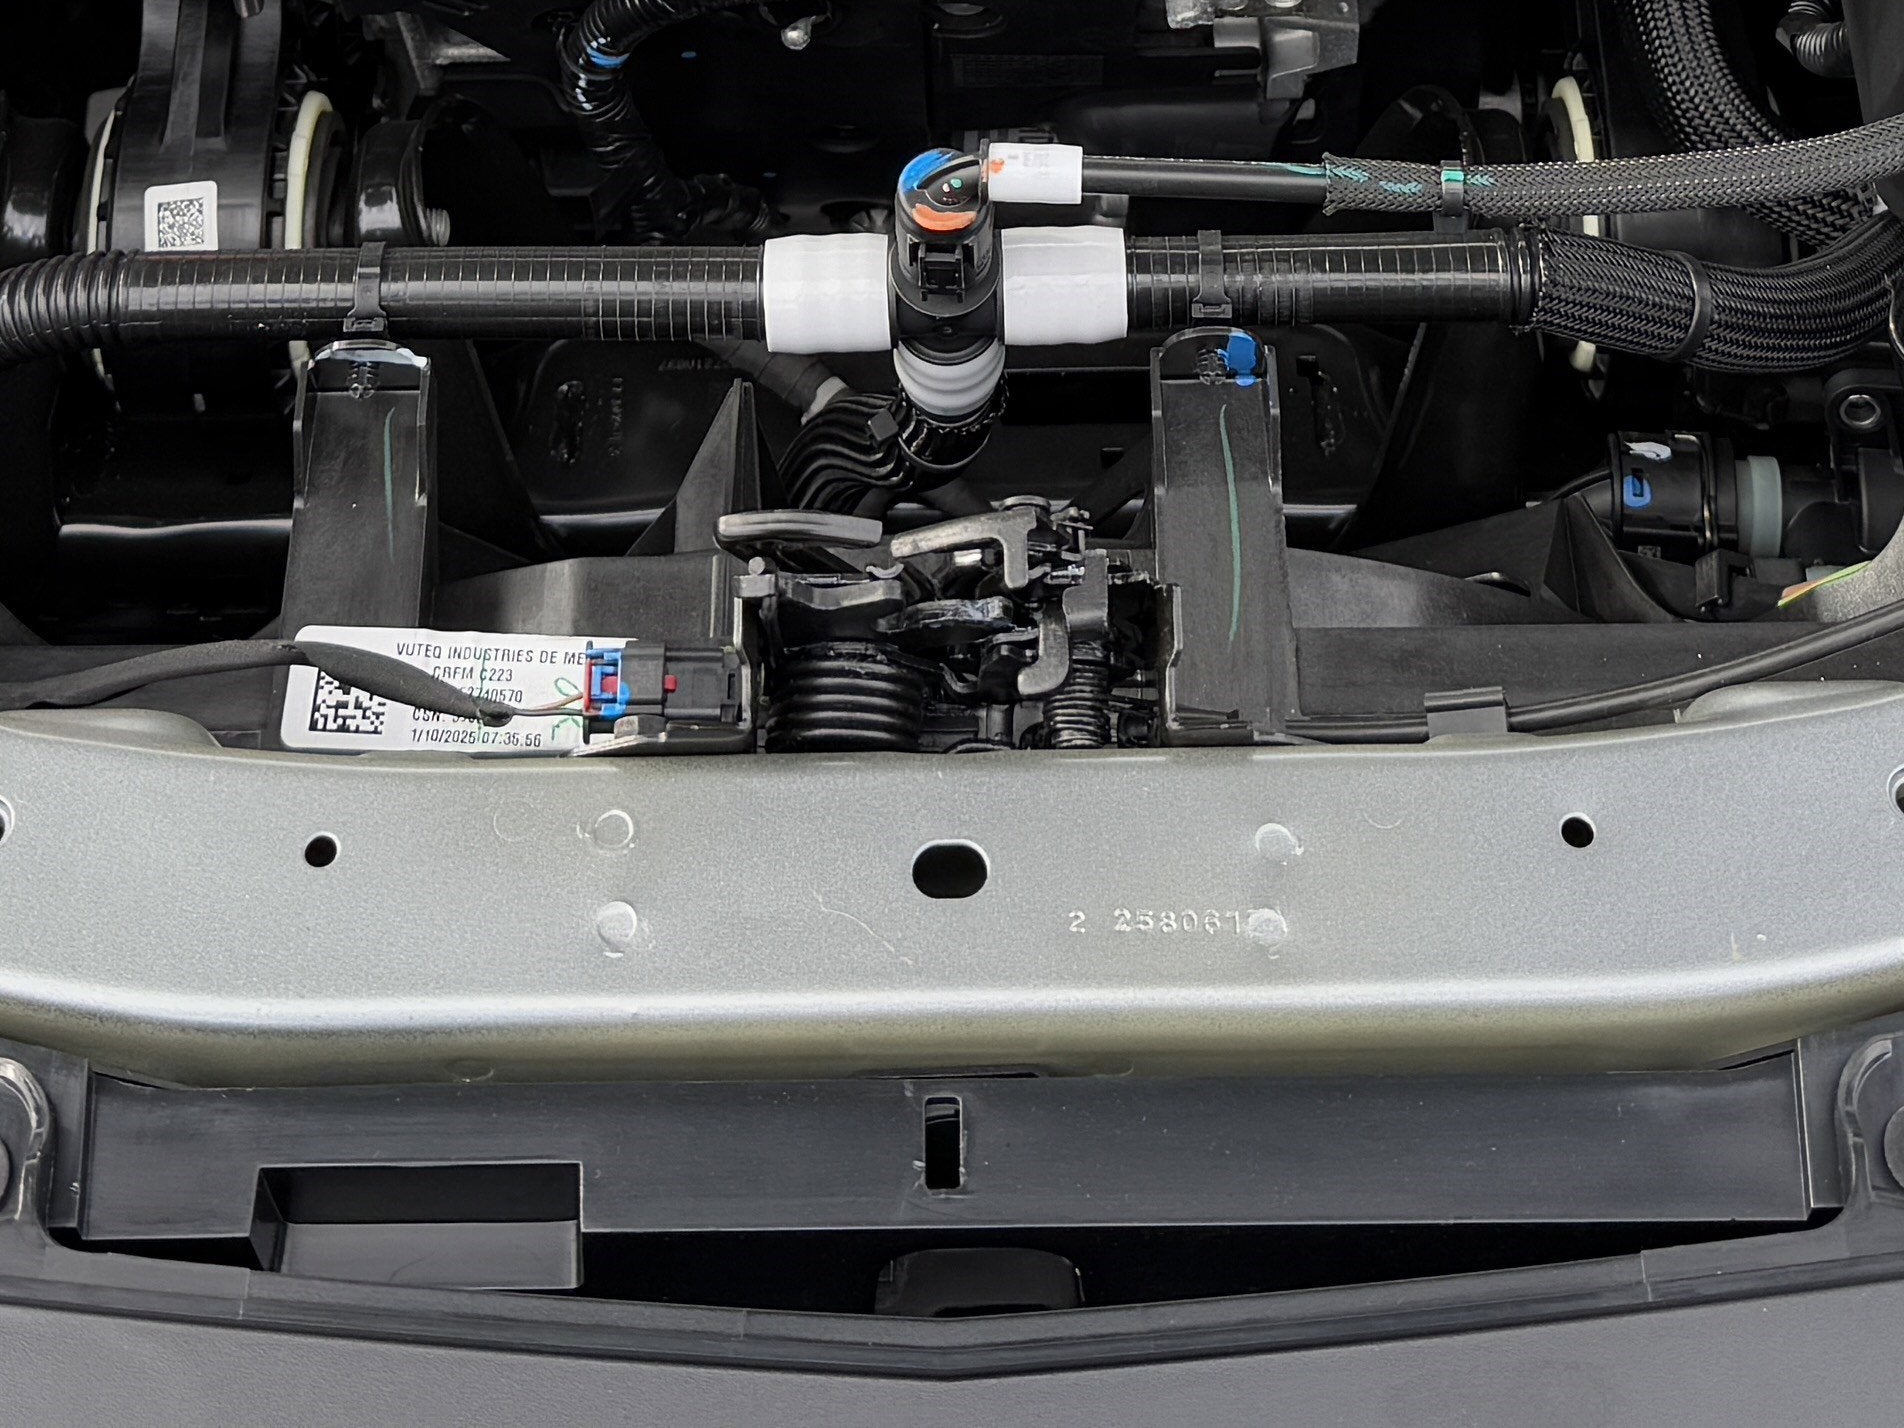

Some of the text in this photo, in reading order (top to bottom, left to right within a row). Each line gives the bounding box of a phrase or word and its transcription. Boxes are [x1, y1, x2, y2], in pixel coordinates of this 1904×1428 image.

[397, 642, 442, 659] VUTEQ
[448, 646, 533, 663] INDUSTRIES
[539, 651, 558, 664] DE
